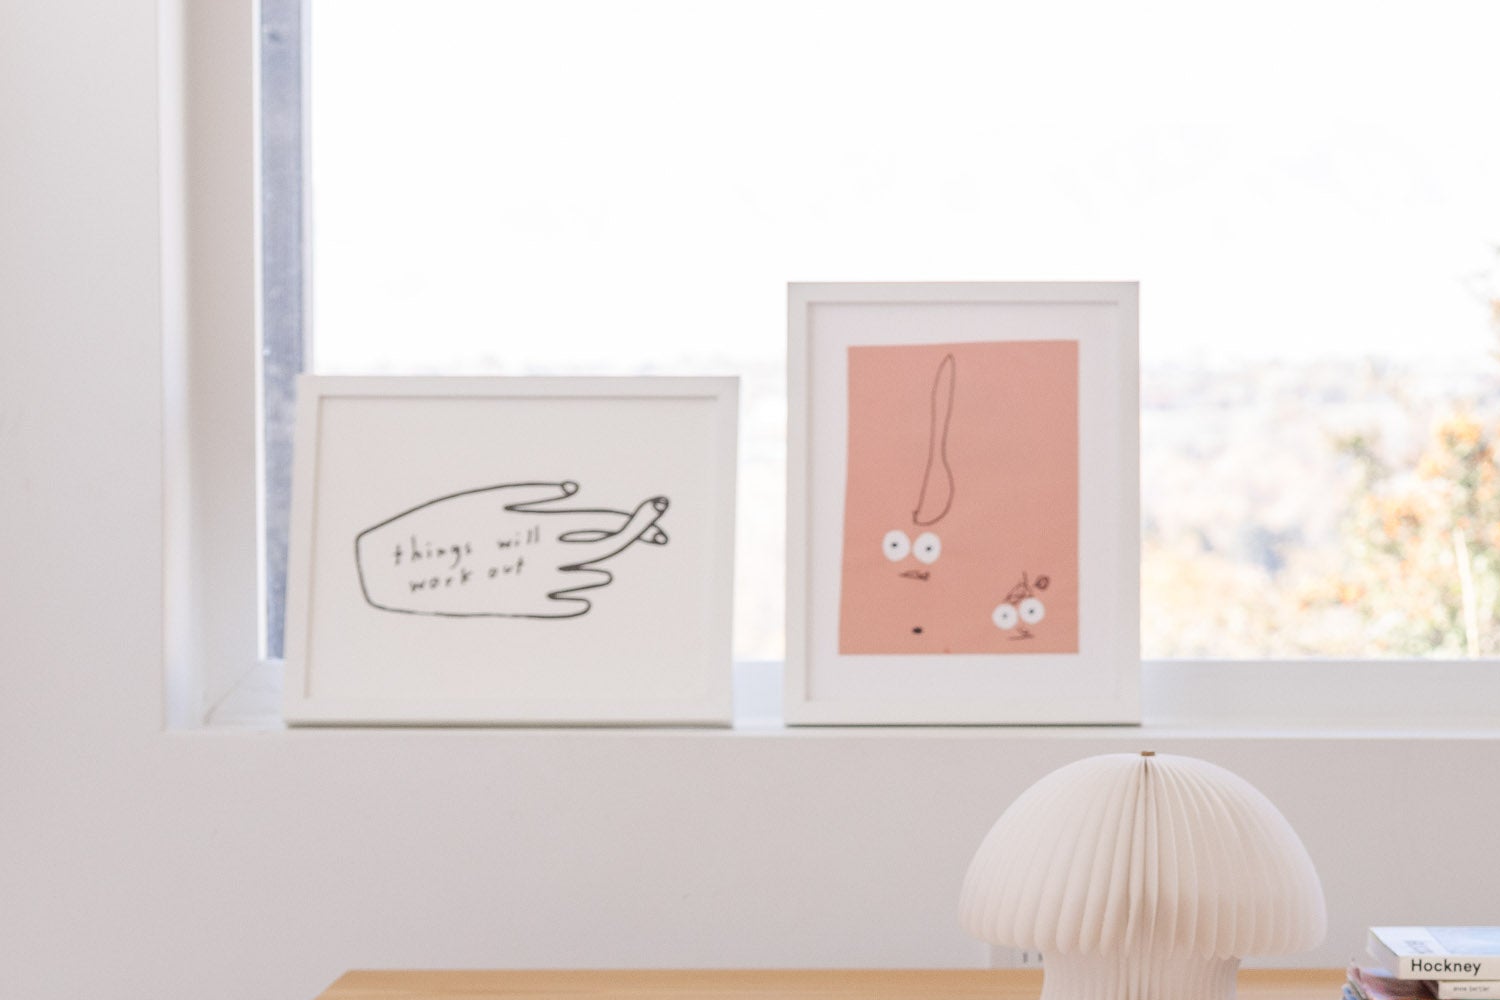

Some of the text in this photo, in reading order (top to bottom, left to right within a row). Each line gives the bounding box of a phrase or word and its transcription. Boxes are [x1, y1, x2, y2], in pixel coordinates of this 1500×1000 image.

[393, 526, 540, 569] things will
[409, 559, 524, 592] work out
[1411, 958, 1482, 976] Hockney
